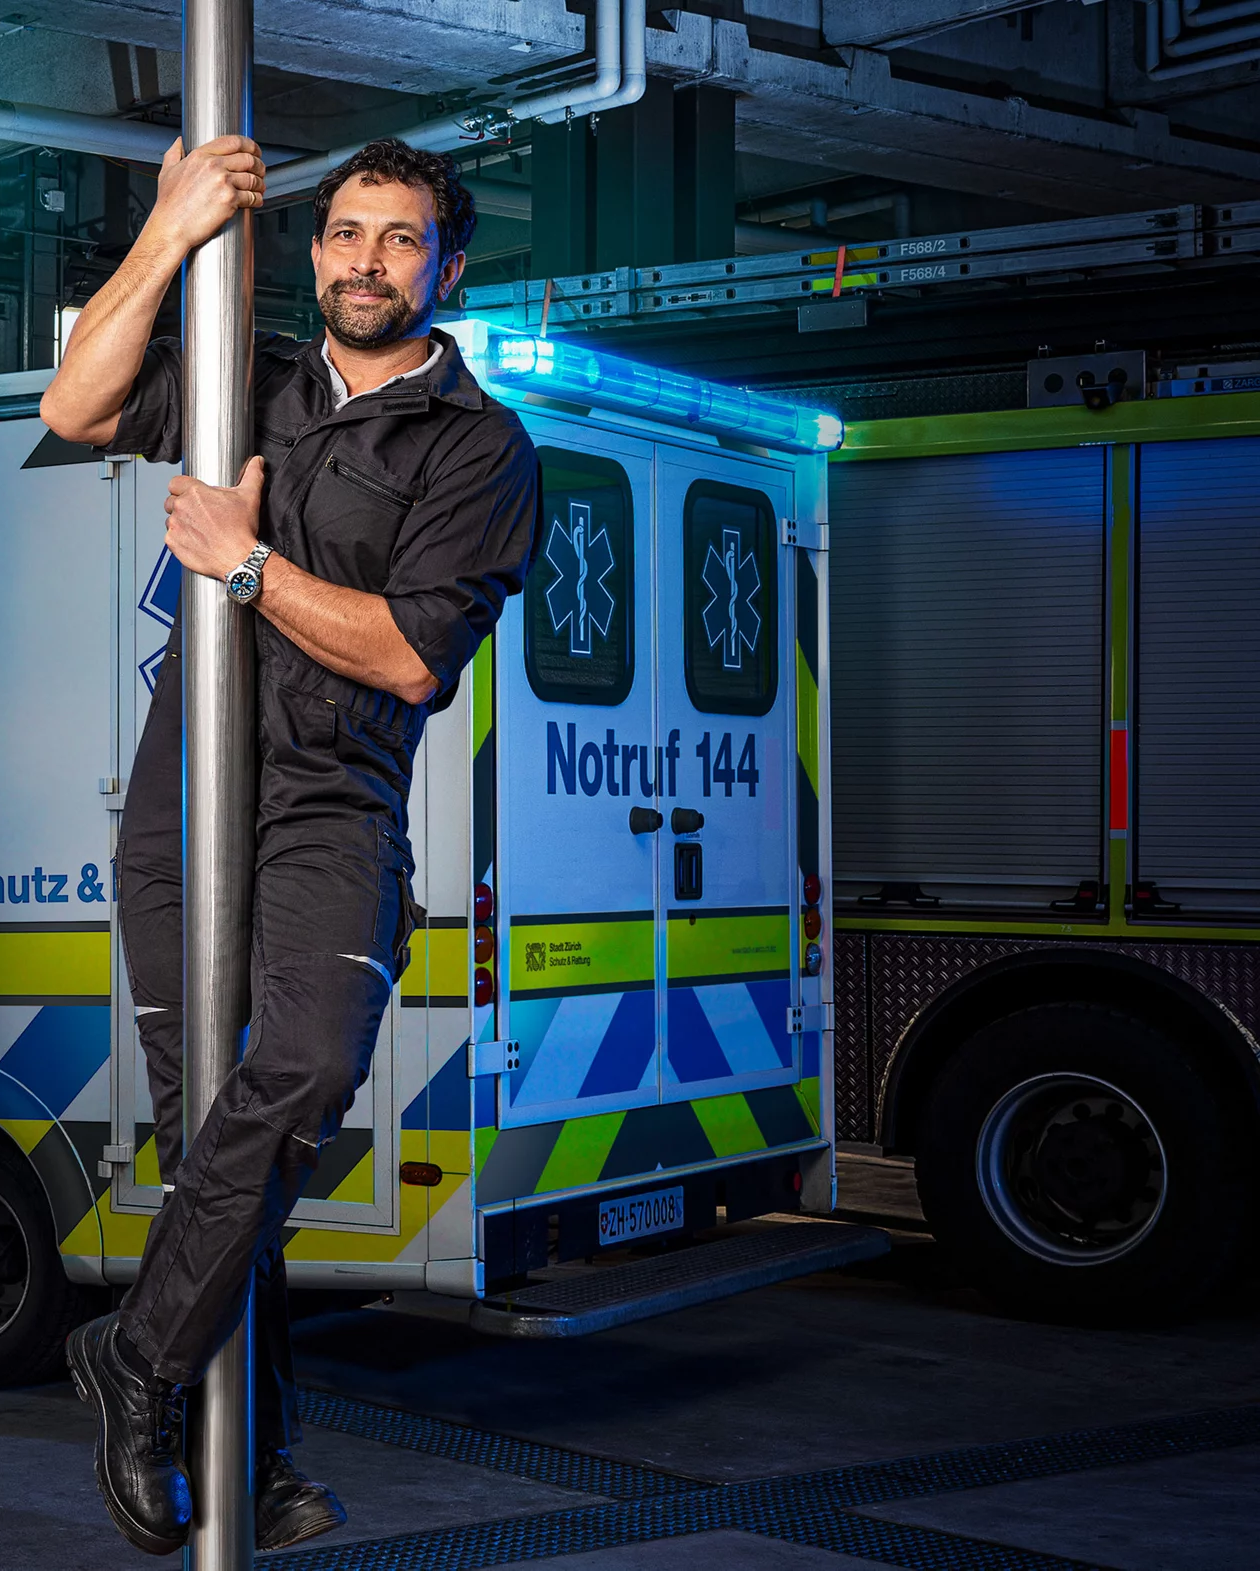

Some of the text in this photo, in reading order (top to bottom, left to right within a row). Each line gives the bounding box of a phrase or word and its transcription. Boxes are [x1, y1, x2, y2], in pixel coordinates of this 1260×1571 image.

[900, 240, 946, 255] F568/2
[901, 266, 946, 281] F568/4
[546, 721, 759, 798] Notruf 144
[76, 862, 107, 903] &
